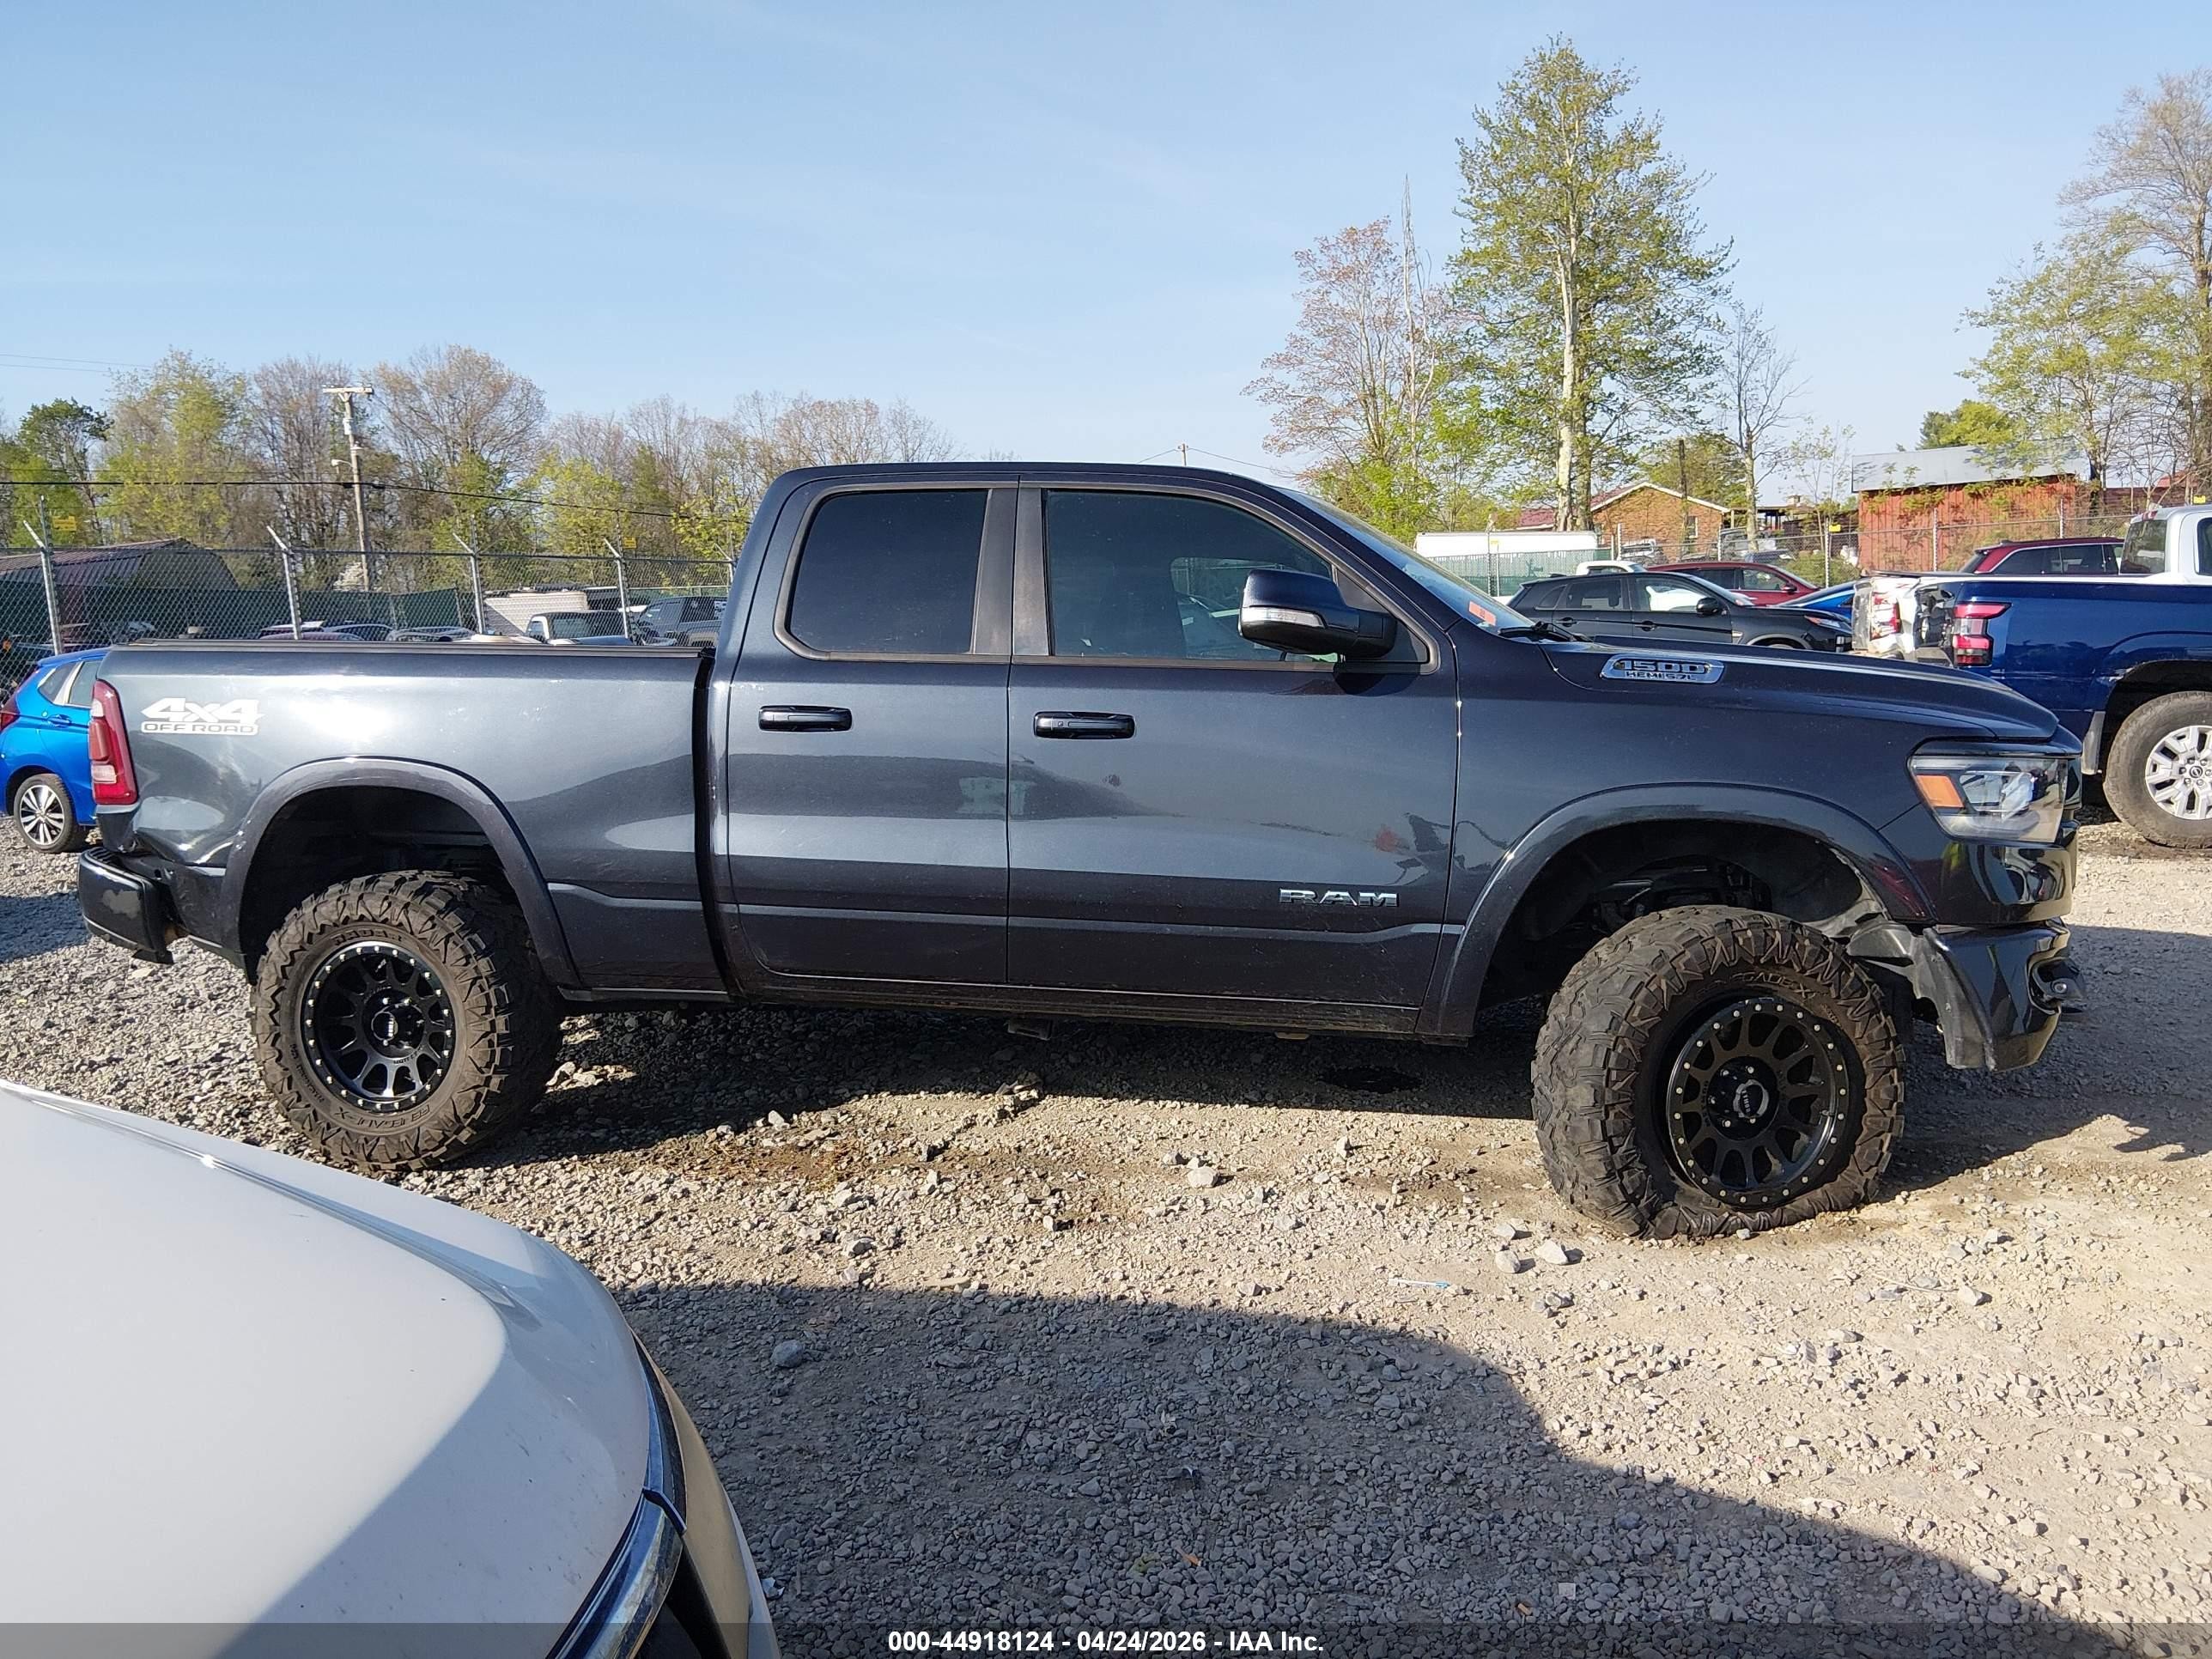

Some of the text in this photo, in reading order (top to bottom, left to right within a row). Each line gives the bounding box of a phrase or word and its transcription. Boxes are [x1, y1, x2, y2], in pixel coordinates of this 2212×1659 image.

[1614, 659, 1705, 673] 1500
[1626, 671, 1662, 679] HEMI
[140, 697, 266, 724] 4x4
[143, 723, 255, 733] OFF ROAD
[1279, 888, 1400, 908] RAM
